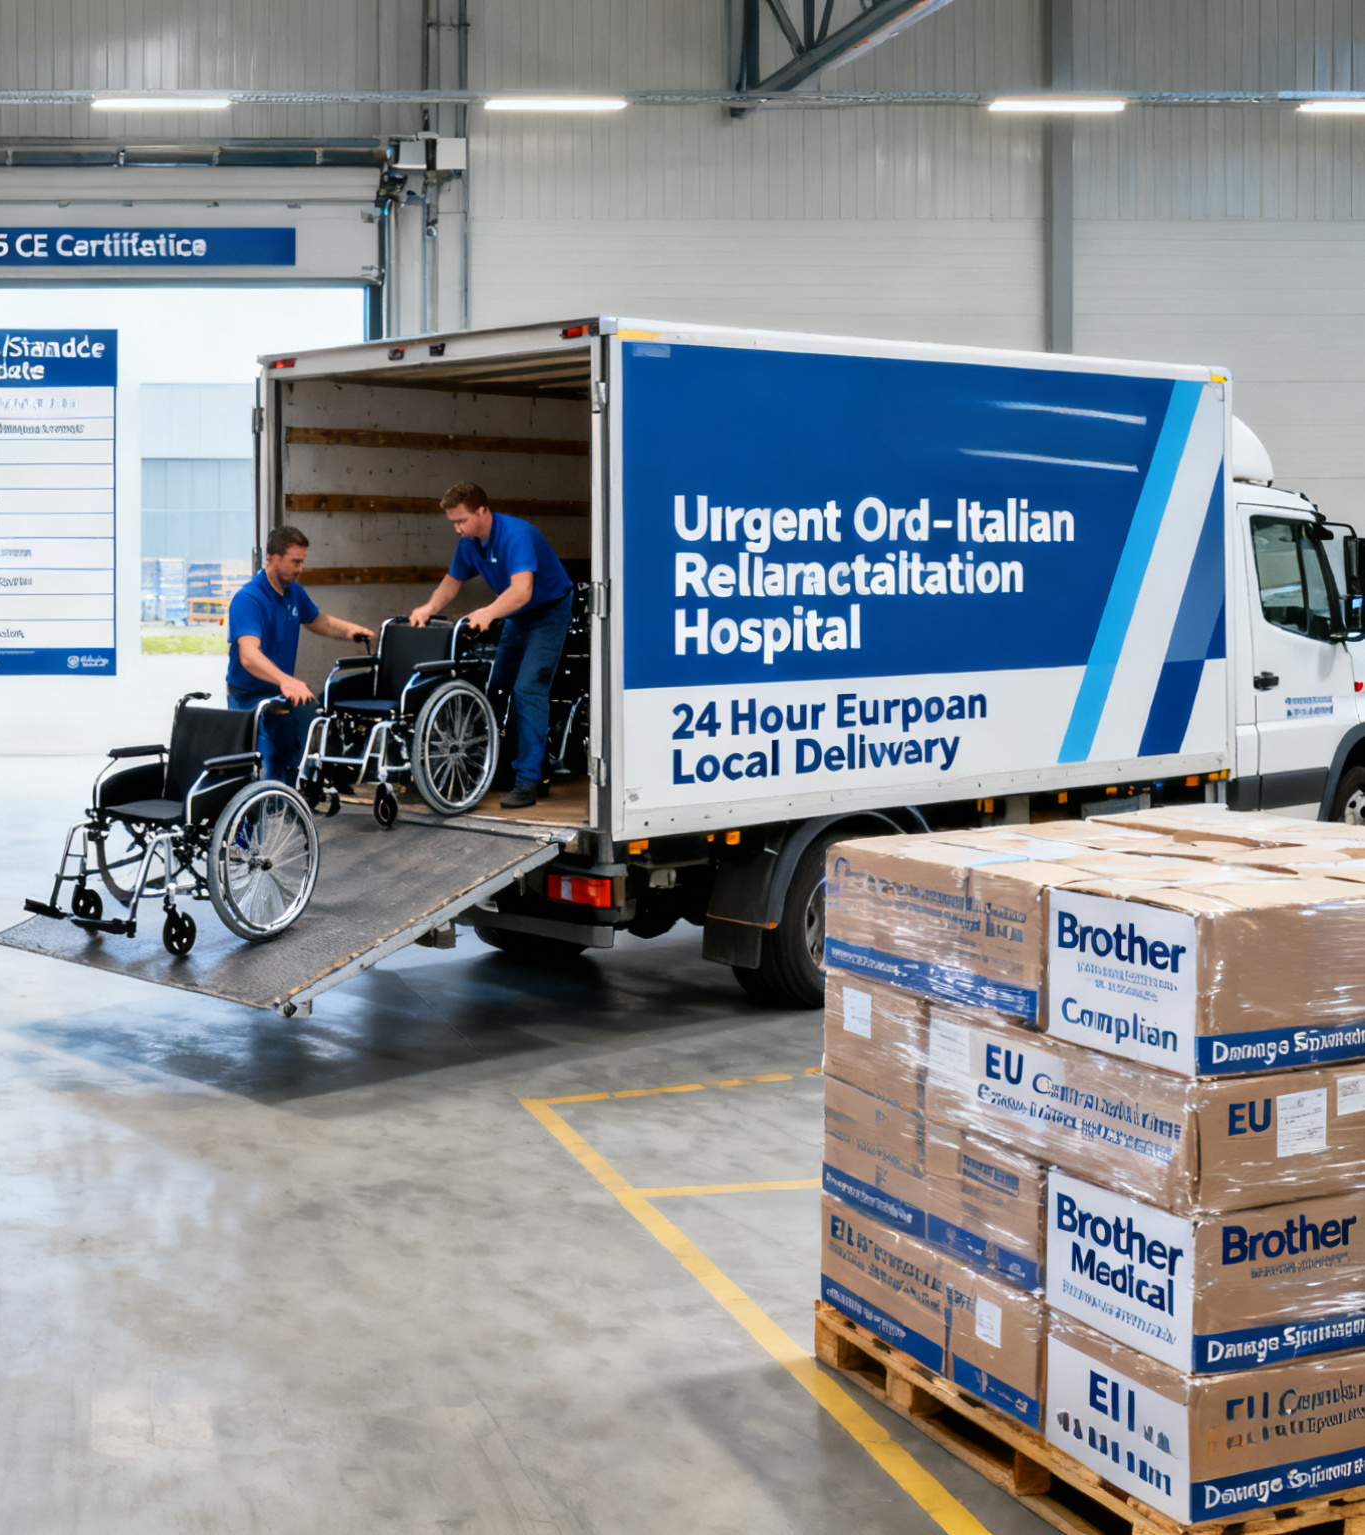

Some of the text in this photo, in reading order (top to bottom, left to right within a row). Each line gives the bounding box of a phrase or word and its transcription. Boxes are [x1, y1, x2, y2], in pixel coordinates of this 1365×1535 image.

[15, 234, 48, 257] CE
[674, 604, 862, 665] Hospital
[672, 693, 988, 740] 24 Hour Eurpoan
[673, 739, 780, 785] Local
[1058, 910, 1186, 973] Brother
[986, 1043, 1024, 1085] EU
[1228, 1098, 1272, 1137] EU
[1057, 1192, 1184, 1276] Brother
[1222, 1214, 1357, 1266] Brother
[1072, 1242, 1174, 1317] Medical
